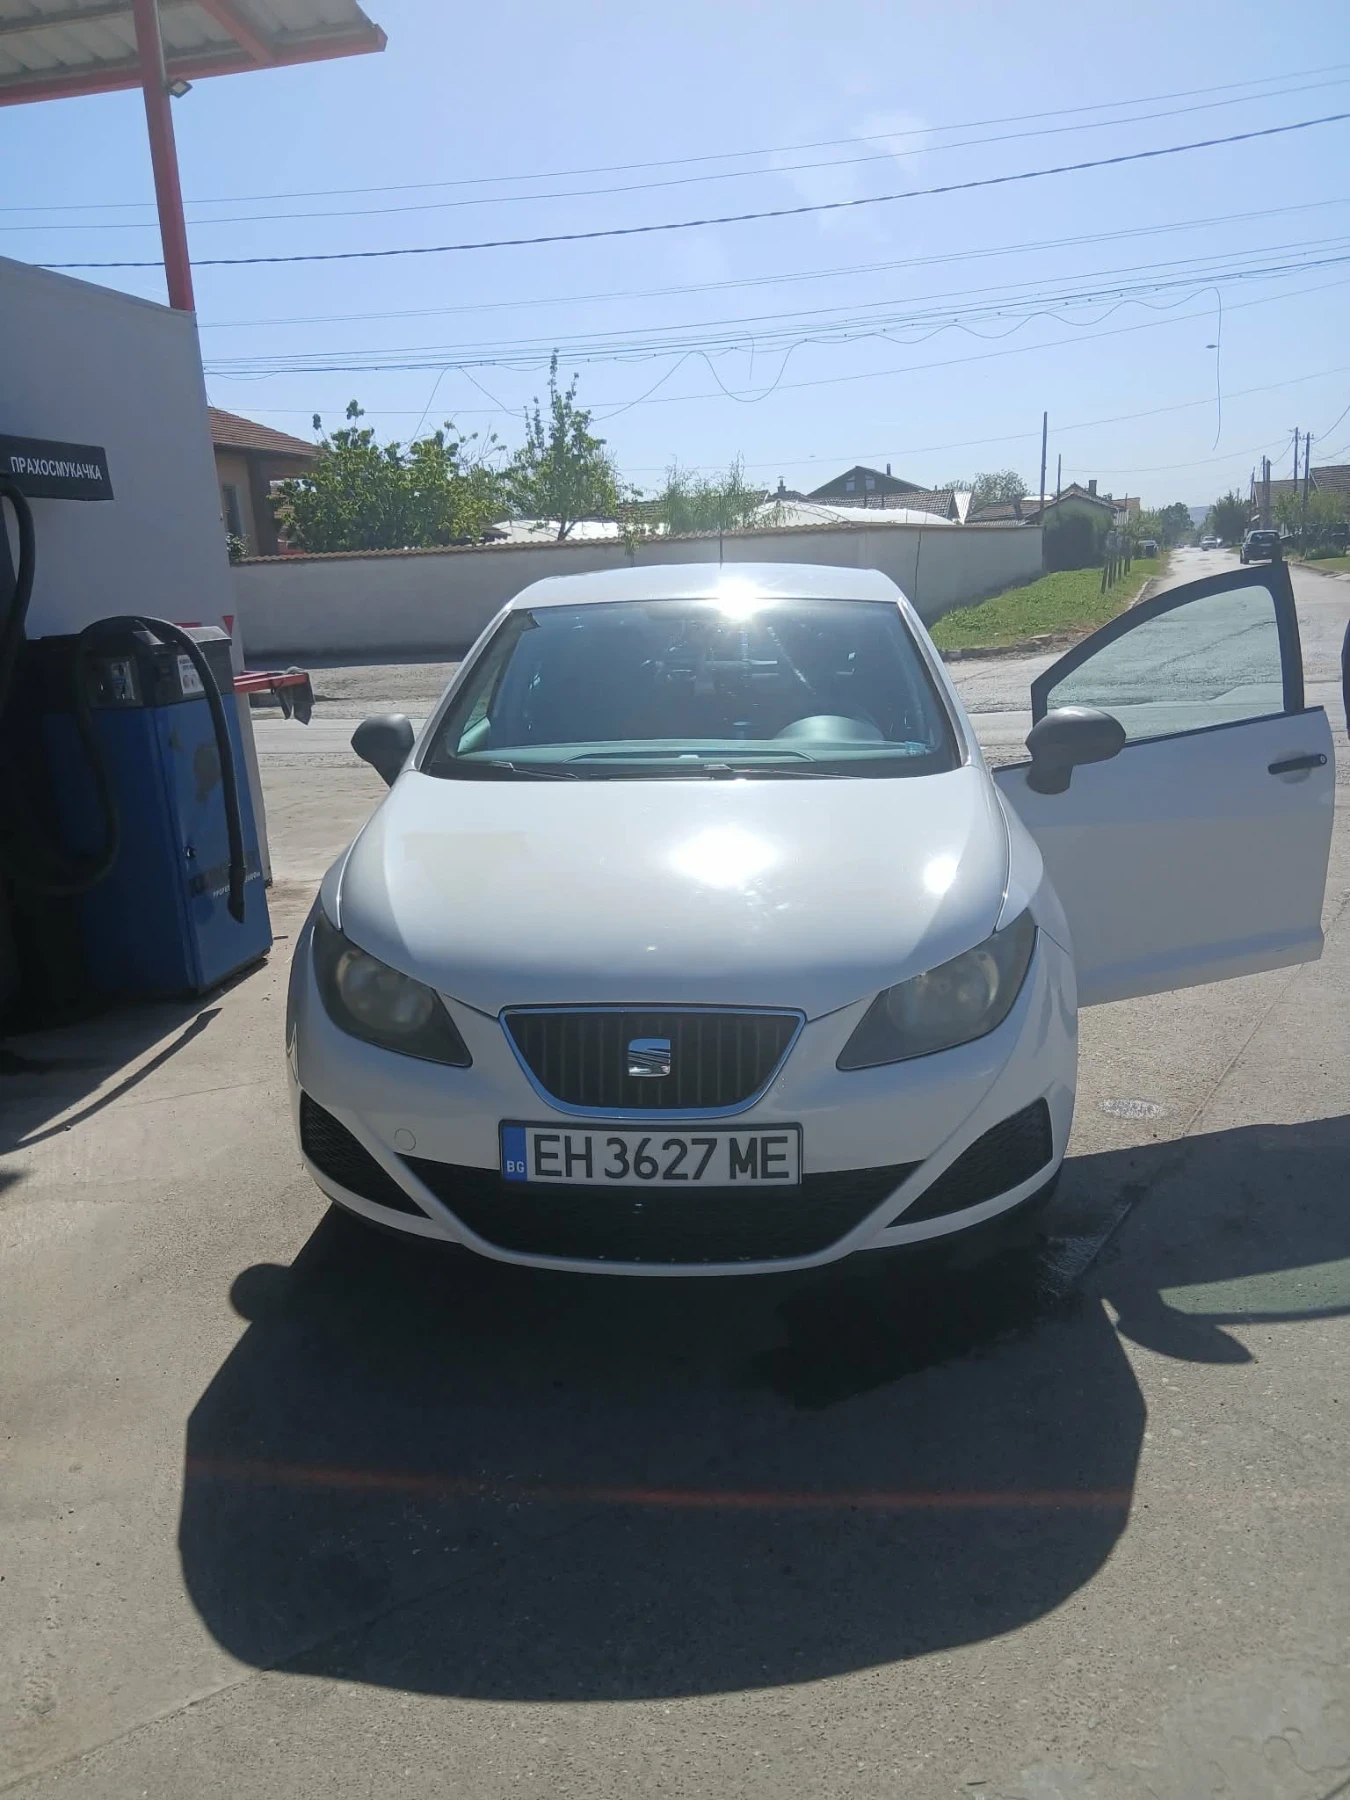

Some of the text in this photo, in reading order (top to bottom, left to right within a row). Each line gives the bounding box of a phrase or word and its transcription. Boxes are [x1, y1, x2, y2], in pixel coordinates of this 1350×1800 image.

[10, 456, 103, 481] ПРАХОСМУКАЧКА
[506, 1160, 525, 1173] BG
[604, 1137, 718, 1181] 3627
